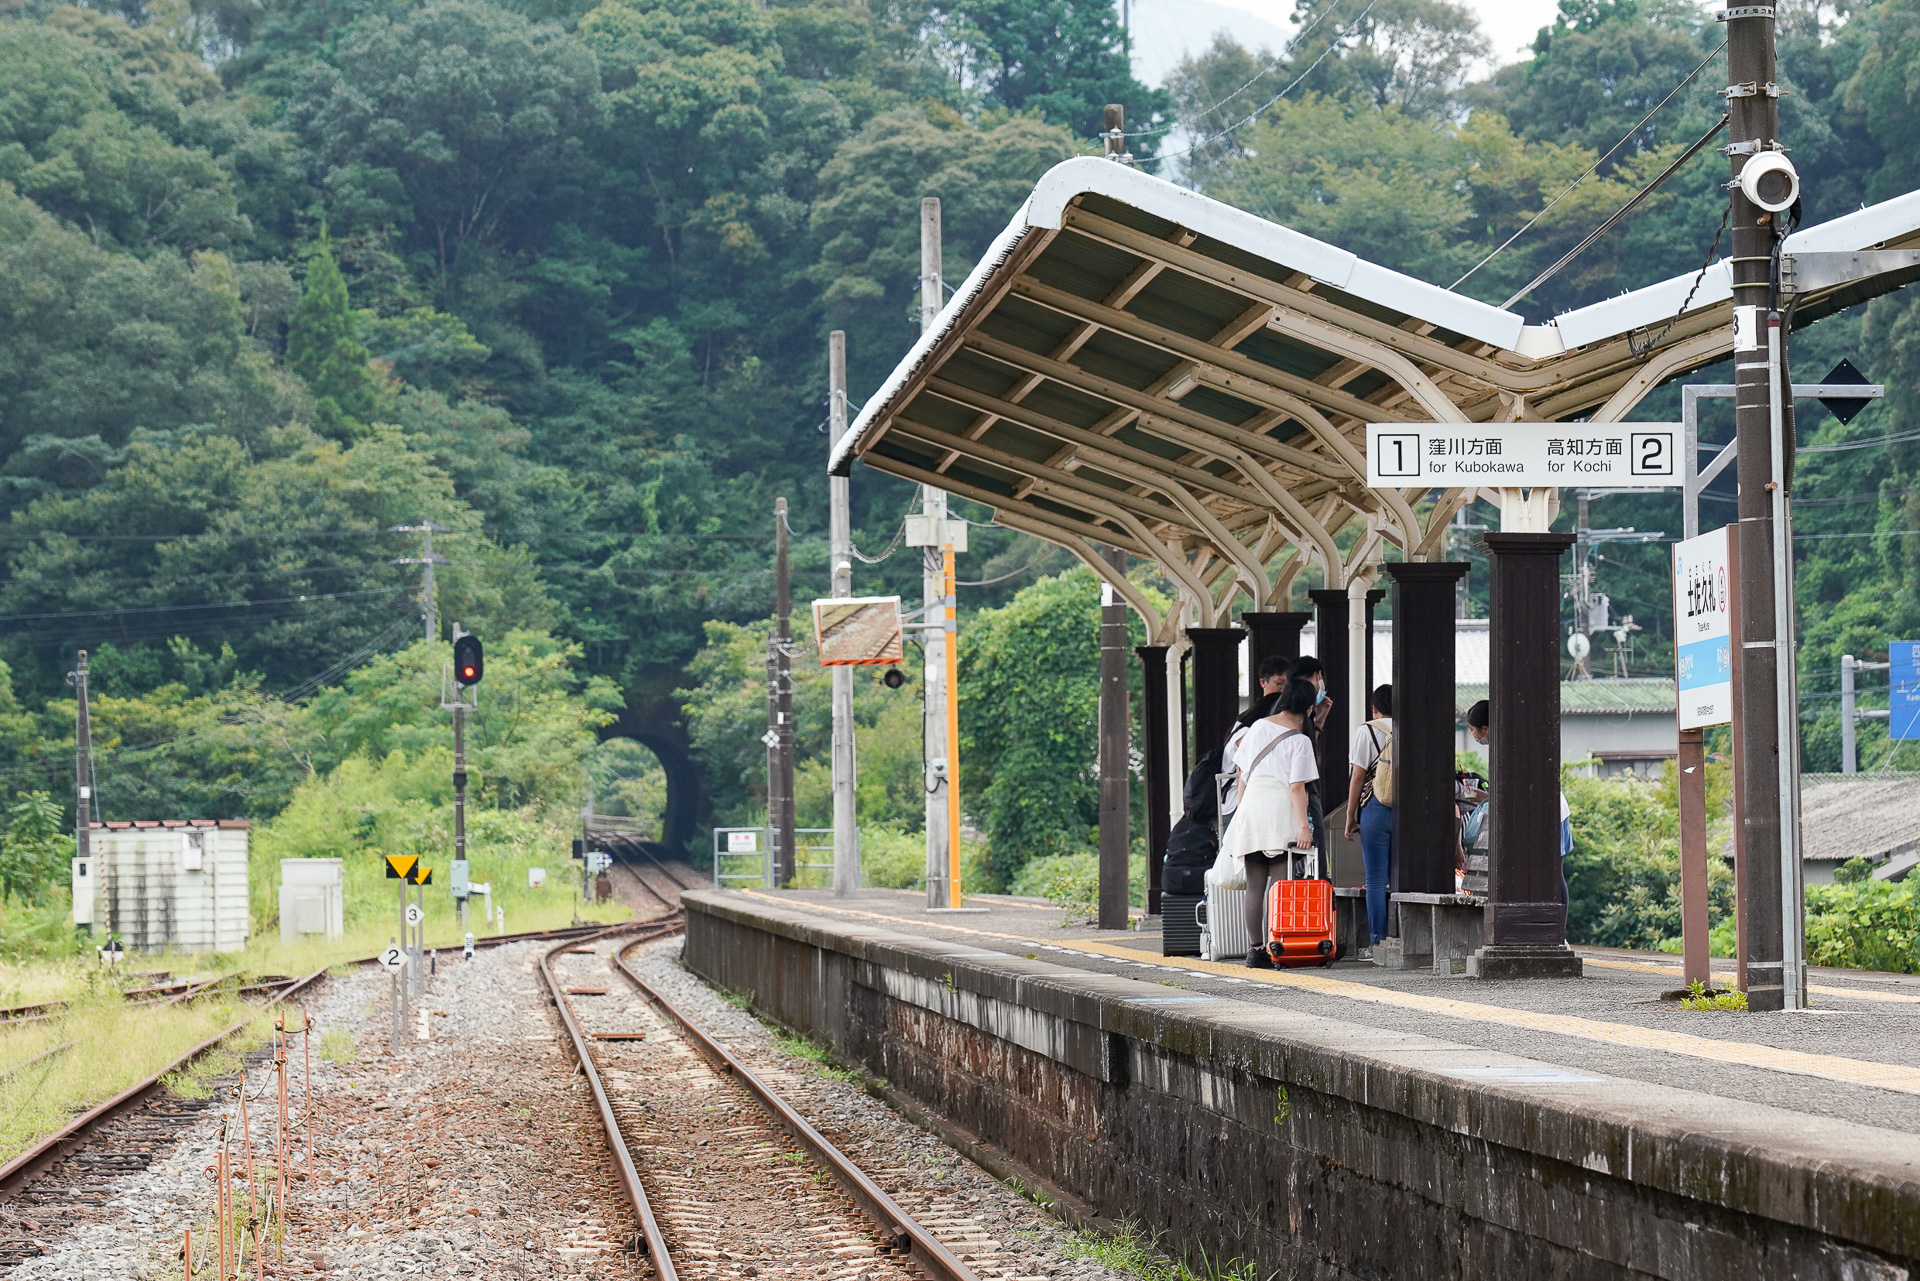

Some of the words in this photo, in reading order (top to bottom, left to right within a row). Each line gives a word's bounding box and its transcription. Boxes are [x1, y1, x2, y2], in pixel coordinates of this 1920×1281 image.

[1429, 438, 1502, 456] 窪川方面
[1547, 438, 1622, 456] 高知方面
[1641, 437, 1663, 470] 2
[1393, 440, 1402, 472] 1
[1429, 461, 1447, 473] for
[1455, 461, 1525, 473] Kubokawa
[1548, 460, 1565, 472] for
[1573, 460, 1612, 472] Kochi
[408, 908, 418, 921] 3
[388, 949, 400, 966] 2
